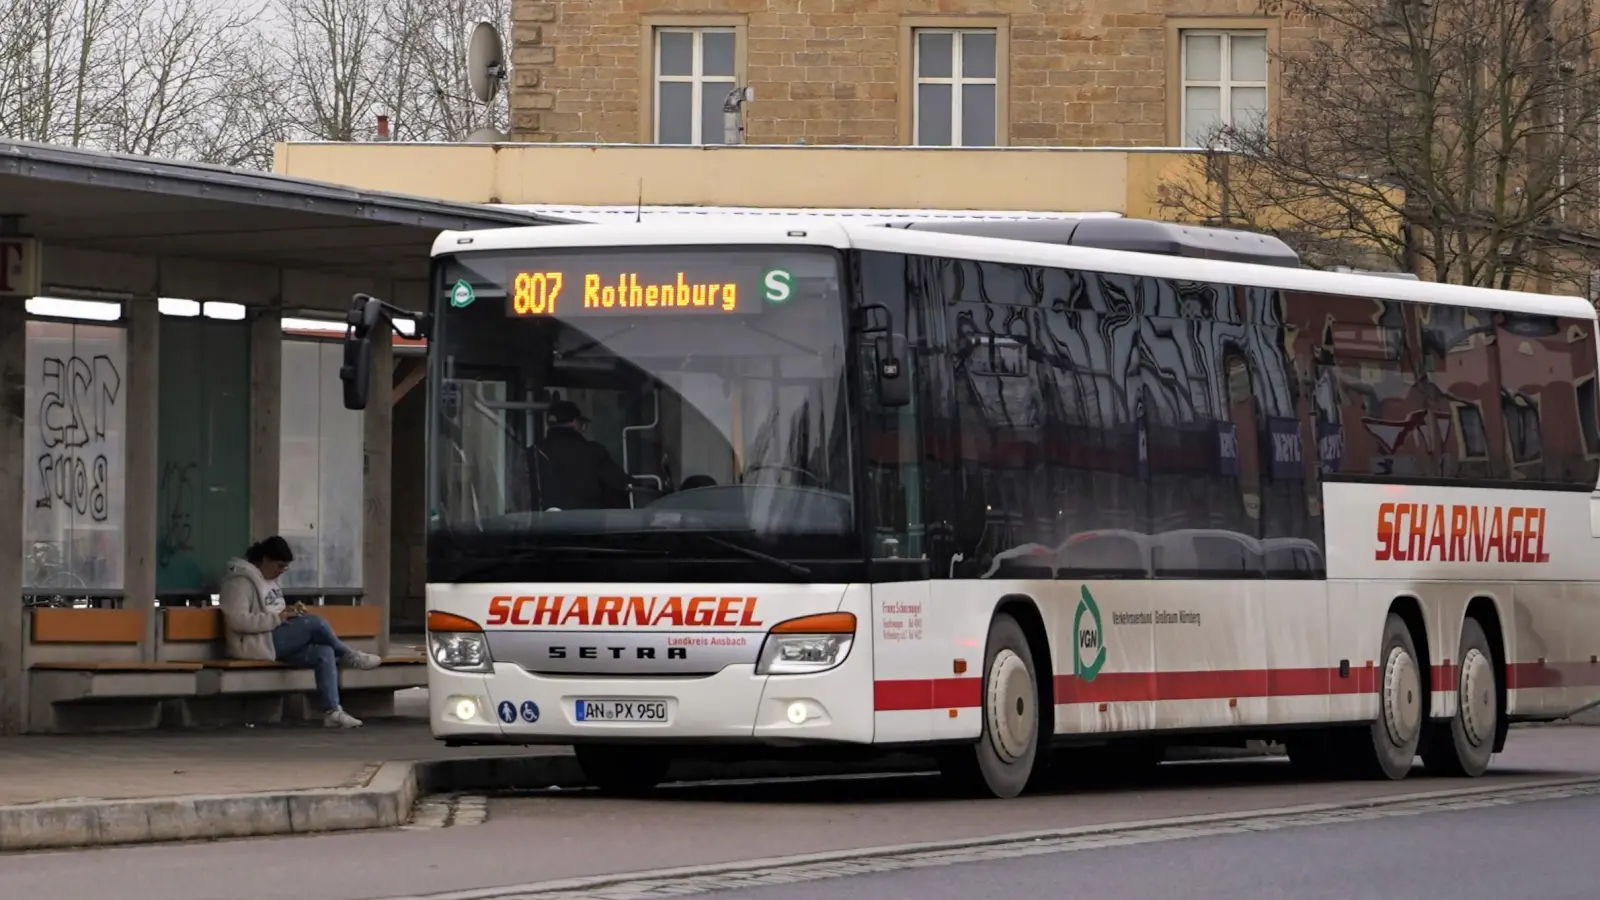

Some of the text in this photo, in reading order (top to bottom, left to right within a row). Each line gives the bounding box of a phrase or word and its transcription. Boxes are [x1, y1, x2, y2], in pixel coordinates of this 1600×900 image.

[513, 272, 737, 314] 807 Rothenburg
[765, 269, 791, 302] S
[1375, 502, 1550, 563] SCHARNAGEL
[486, 595, 764, 626] SCHARNAGEL
[667, 636, 747, 647] Landkreis Ansbach
[1080, 629, 1097, 649] VGN
[548, 645, 688, 660] SETRA
[586, 703, 665, 719] AN PX 950
